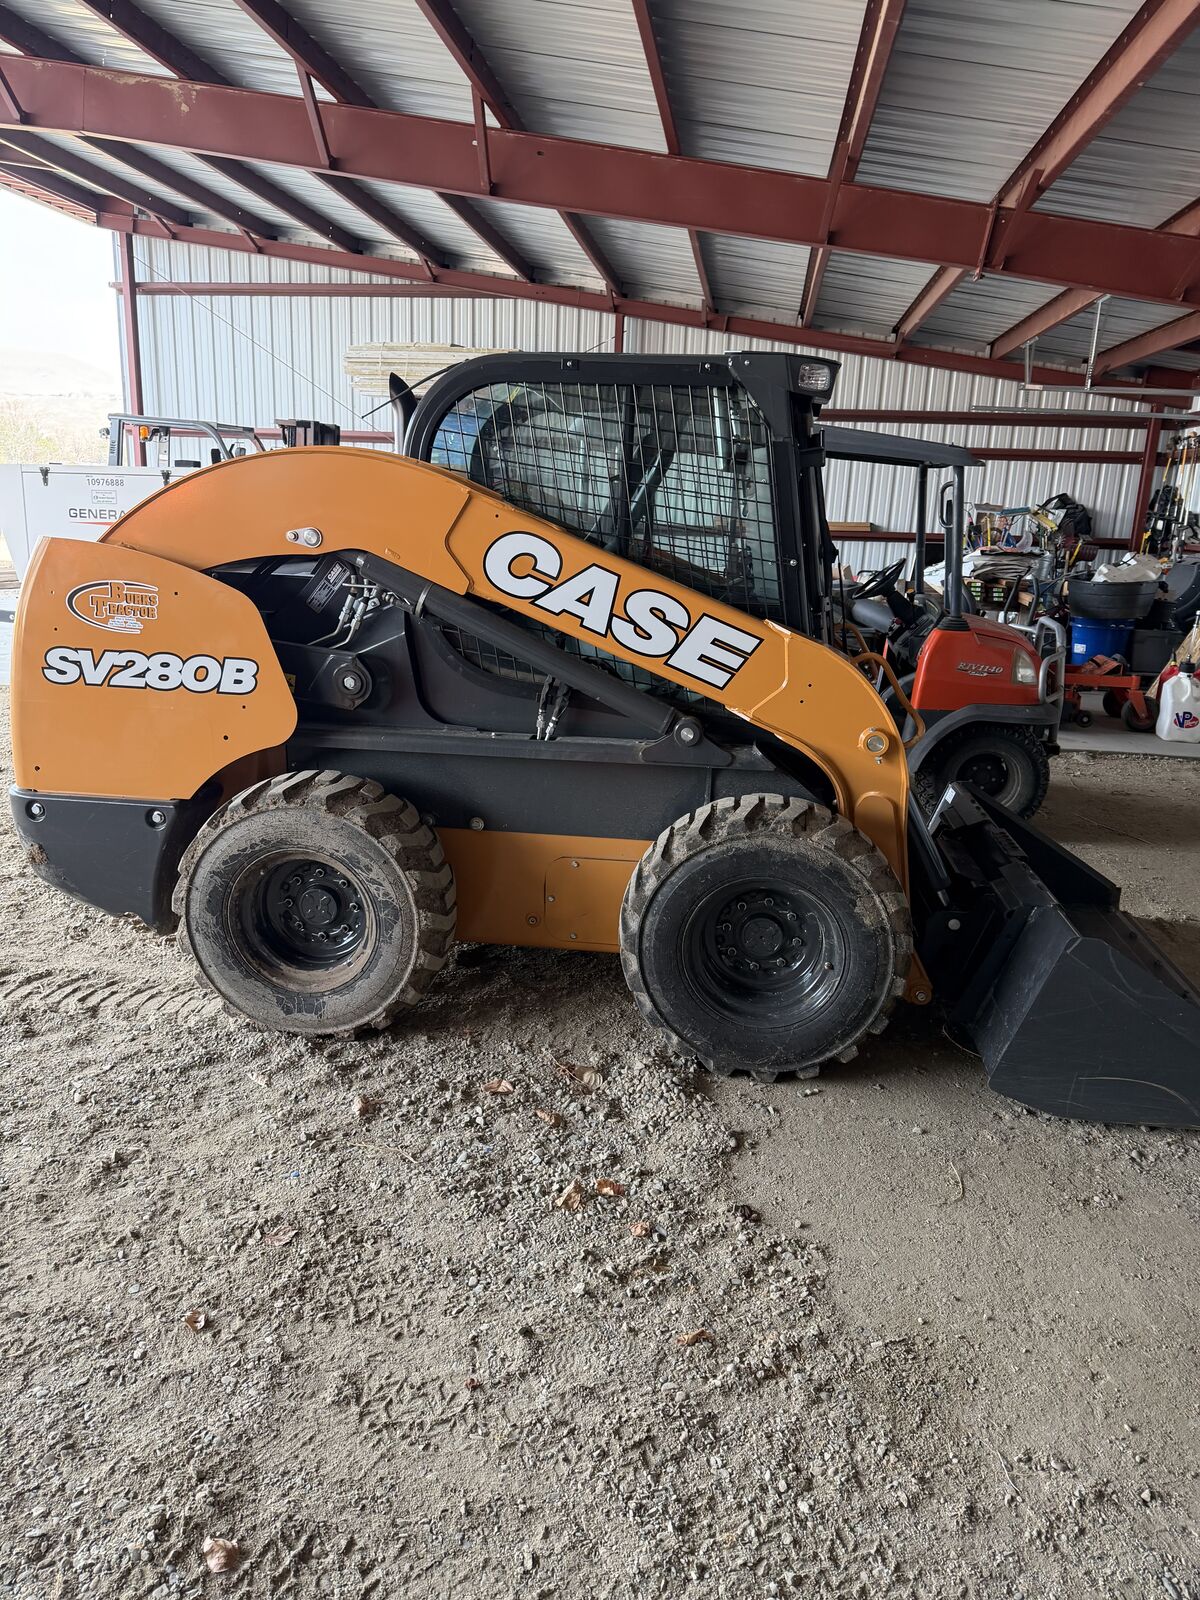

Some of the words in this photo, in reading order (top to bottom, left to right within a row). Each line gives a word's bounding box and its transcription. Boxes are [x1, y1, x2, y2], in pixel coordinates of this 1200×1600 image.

[87, 478, 125, 487] 10976888
[90, 595, 157, 619] TRACTOR
[483, 531, 764, 691] CASE
[41, 645, 260, 696] SV280B
[1175, 711, 1193, 729] VP
